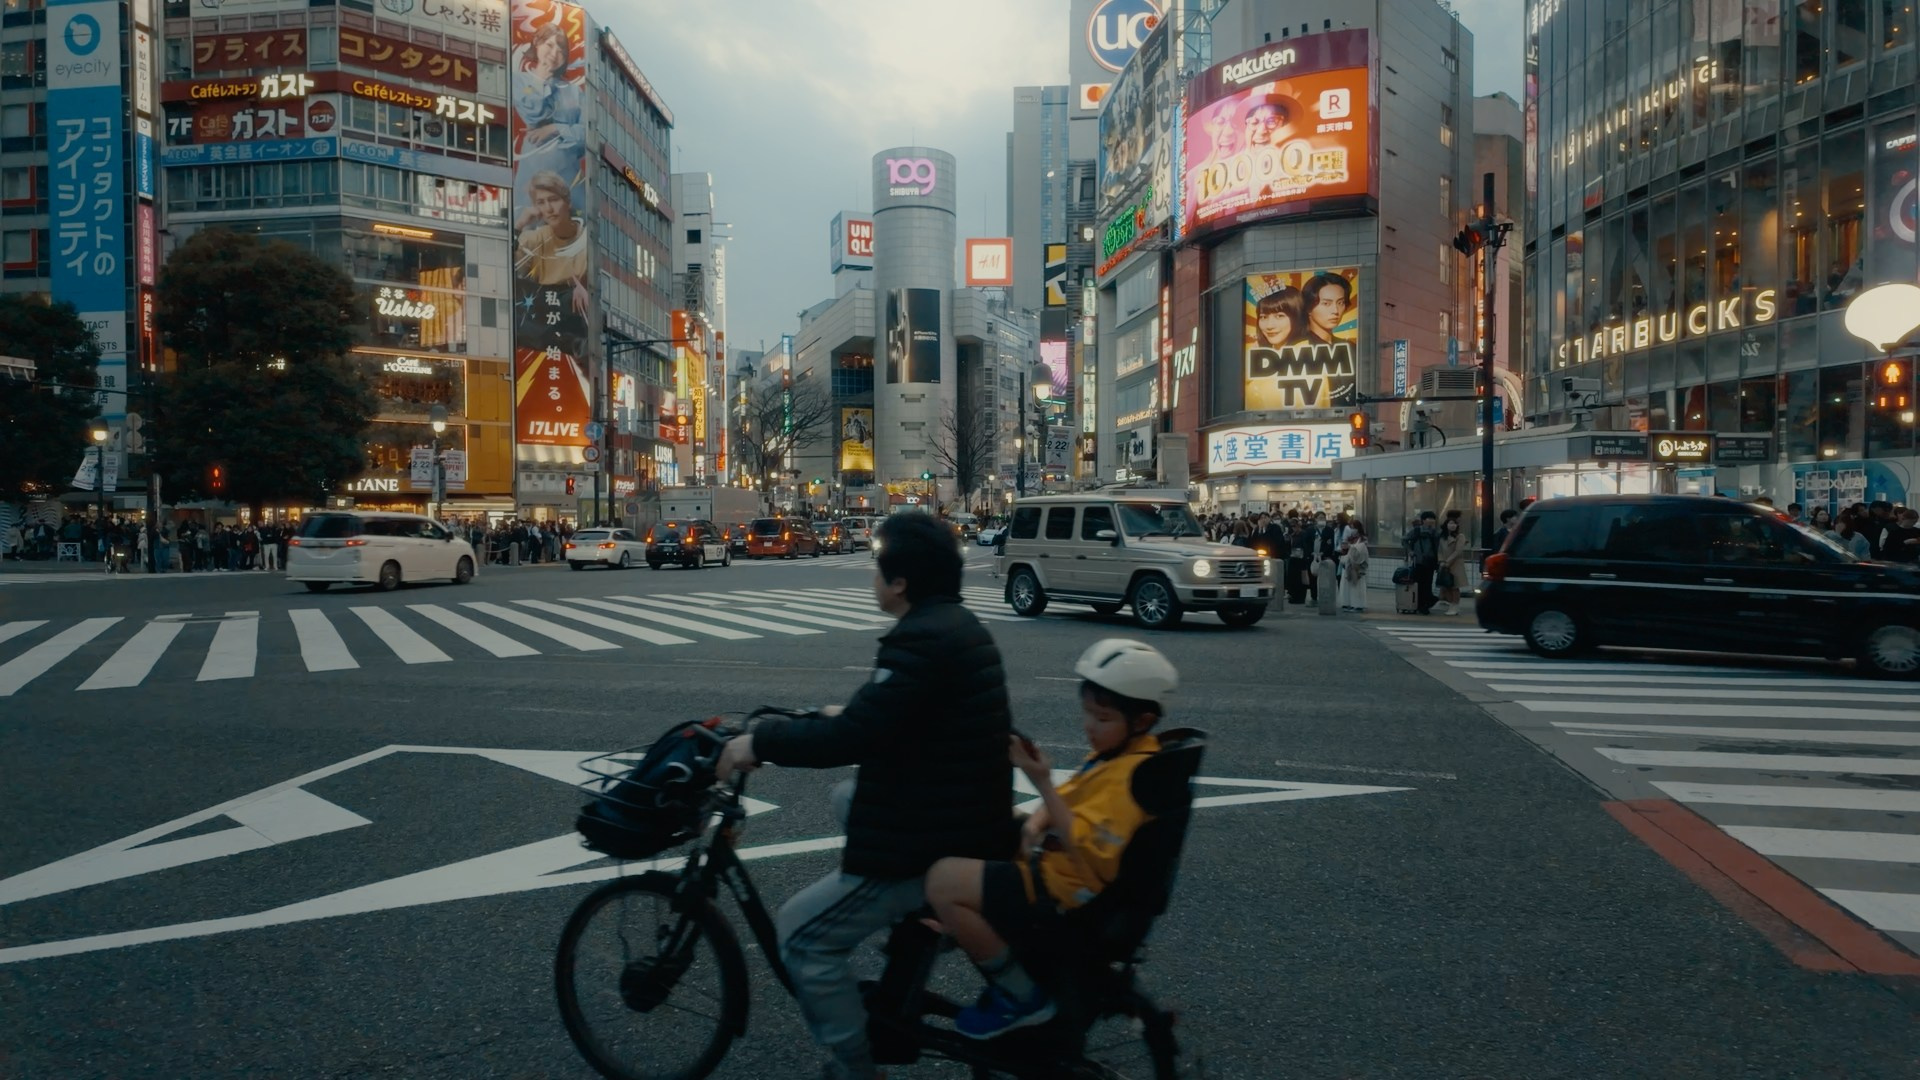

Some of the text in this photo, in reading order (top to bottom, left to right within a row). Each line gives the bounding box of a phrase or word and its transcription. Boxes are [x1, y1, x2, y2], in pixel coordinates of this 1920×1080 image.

[422, 0, 502, 33] しゃぶ葉
[195, 33, 304, 64] プライス
[340, 32, 473, 82] コンタクト
[55, 60, 111, 78] eyecity
[1222, 48, 1296, 85] Rakuten
[261, 73, 315, 99] ガスト
[435, 95, 495, 125] ガスト
[1328, 94, 1341, 110] R
[168, 118, 193, 137] 7F
[232, 108, 298, 140] ガスト
[885, 157, 936, 196] 109
[889, 187, 920, 197] SHIBUYA
[56, 117, 90, 277] アイシティ
[92, 117, 116, 277] コンタクトの
[1557, 288, 1777, 368] STARBUCKS
[544, 290, 563, 413] 私が、始まる。
[1249, 343, 1353, 379] DMM
[1277, 378, 1323, 406] TV
[528, 420, 581, 437] 17LIVE
[654, 444, 673, 464] LUSH
[1213, 432, 1343, 464] 大盛堂書店
[1673, 440, 1708, 452] しぶちか
